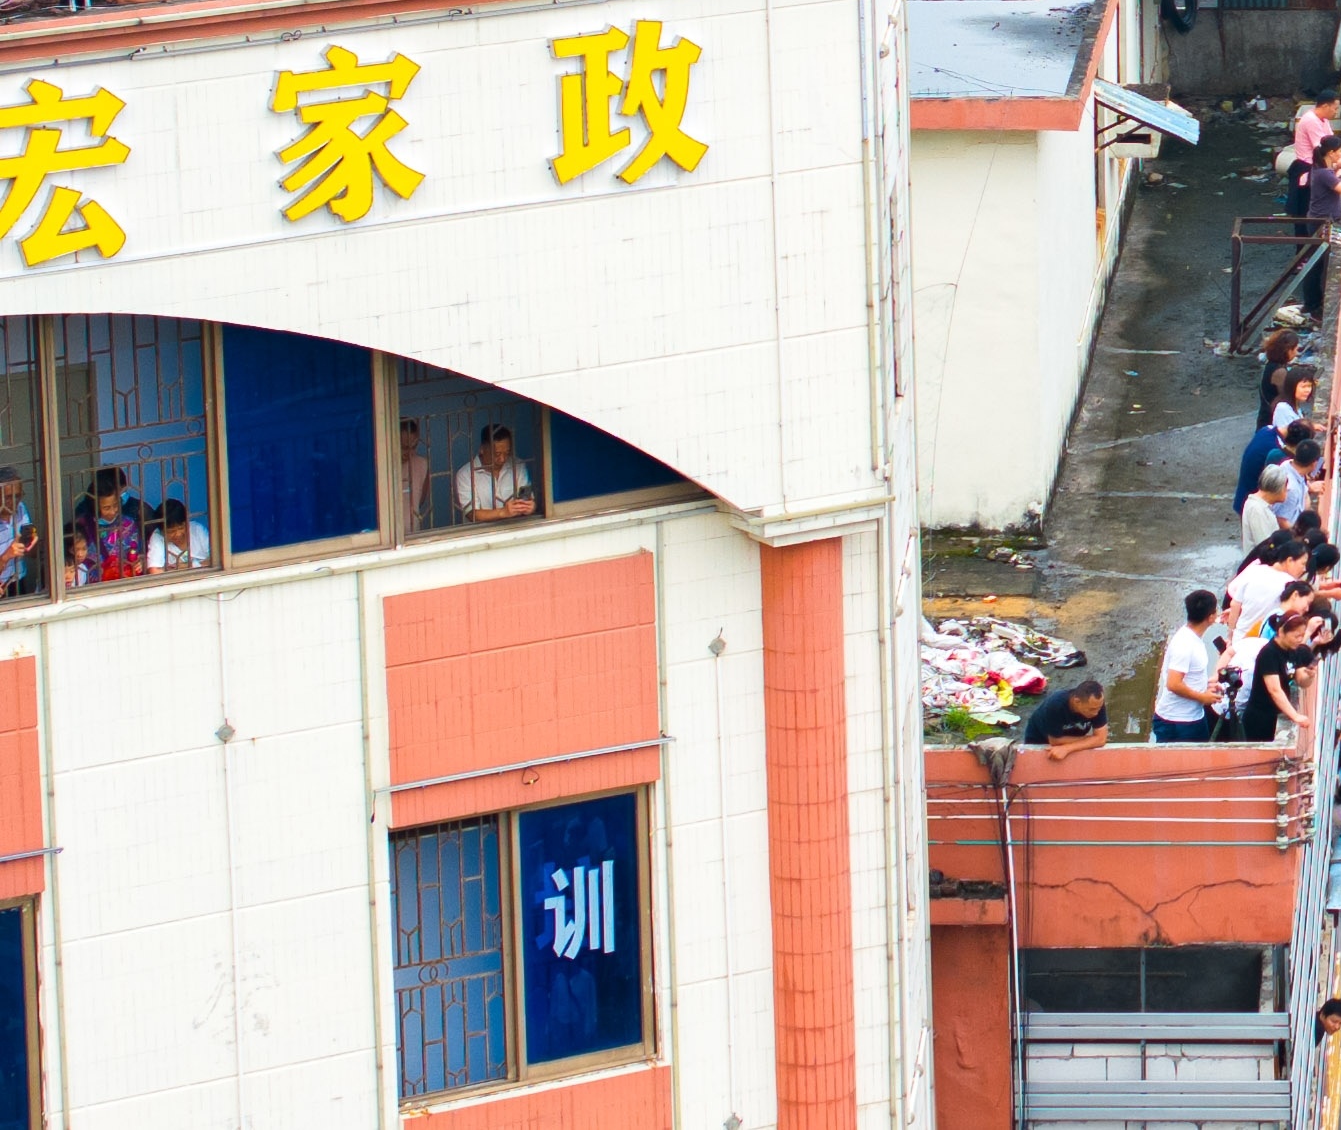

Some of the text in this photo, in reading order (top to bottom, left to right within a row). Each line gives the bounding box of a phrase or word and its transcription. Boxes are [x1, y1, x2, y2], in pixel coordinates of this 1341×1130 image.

[0, 19, 709, 267] 宏家政
[544, 859, 615, 960] 训
